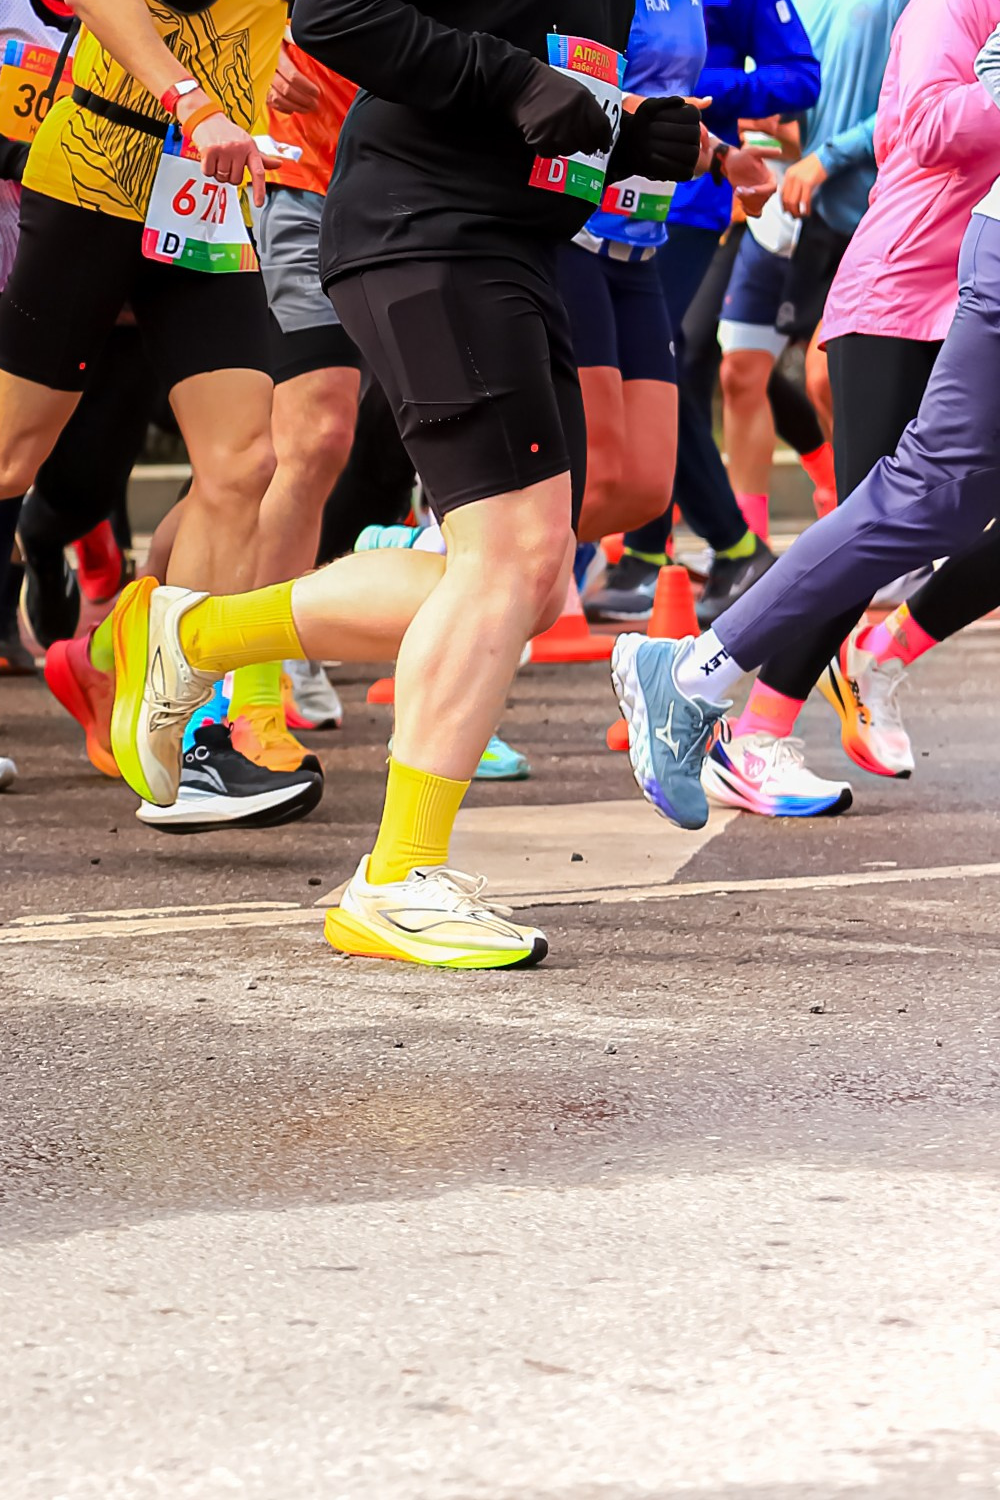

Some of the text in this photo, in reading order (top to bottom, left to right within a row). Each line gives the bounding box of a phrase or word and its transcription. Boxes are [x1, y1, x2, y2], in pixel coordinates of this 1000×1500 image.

[571, 60, 593, 74] забег
[573, 45, 611, 69] АПРЕЛЬ
[547, 159, 564, 183] D
[621, 189, 635, 208] B
[162, 232, 180, 255] D
